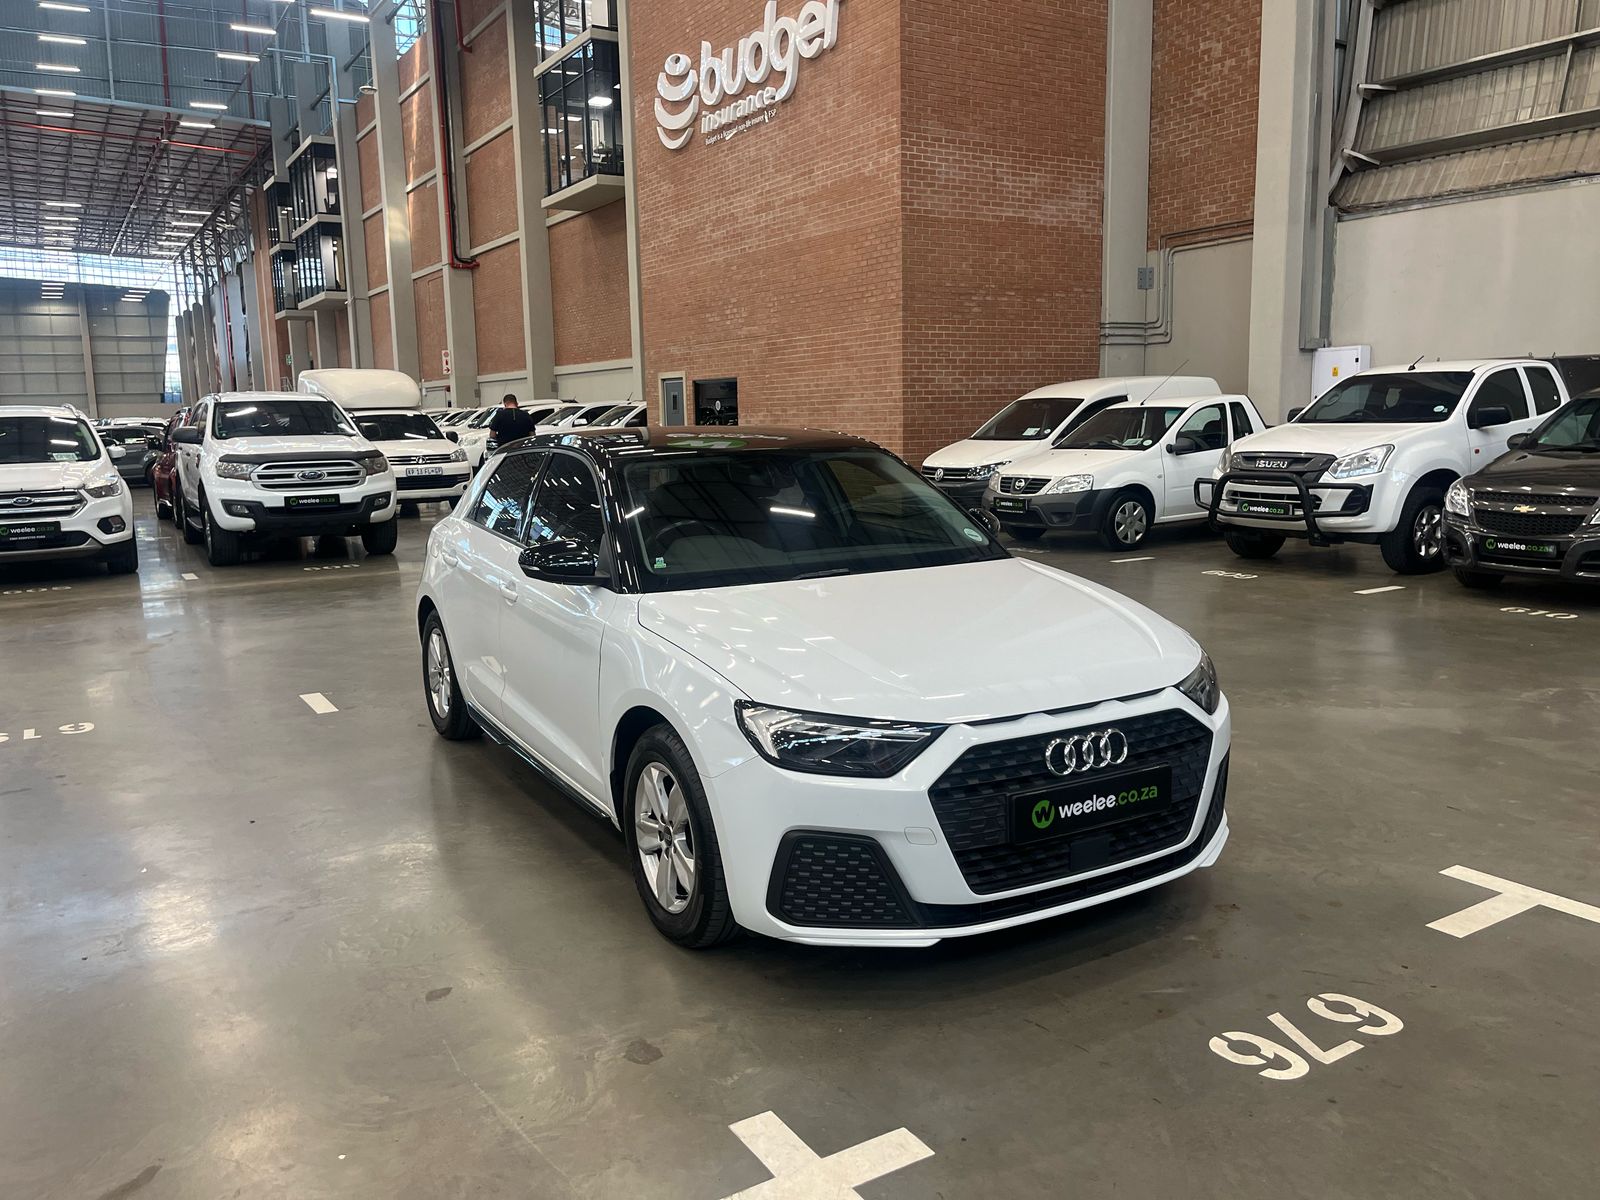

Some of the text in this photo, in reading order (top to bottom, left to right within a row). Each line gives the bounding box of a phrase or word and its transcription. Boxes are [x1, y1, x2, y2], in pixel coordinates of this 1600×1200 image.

[701, 87, 777, 134] insurance
[1255, 460, 1288, 469] ISUZU
[1497, 541, 1550, 553] weelee.co.za
[0, 722, 95, 743] 61
[1058, 785, 1158, 819] weelee.co.za
[1208, 992, 1405, 1081] 676
